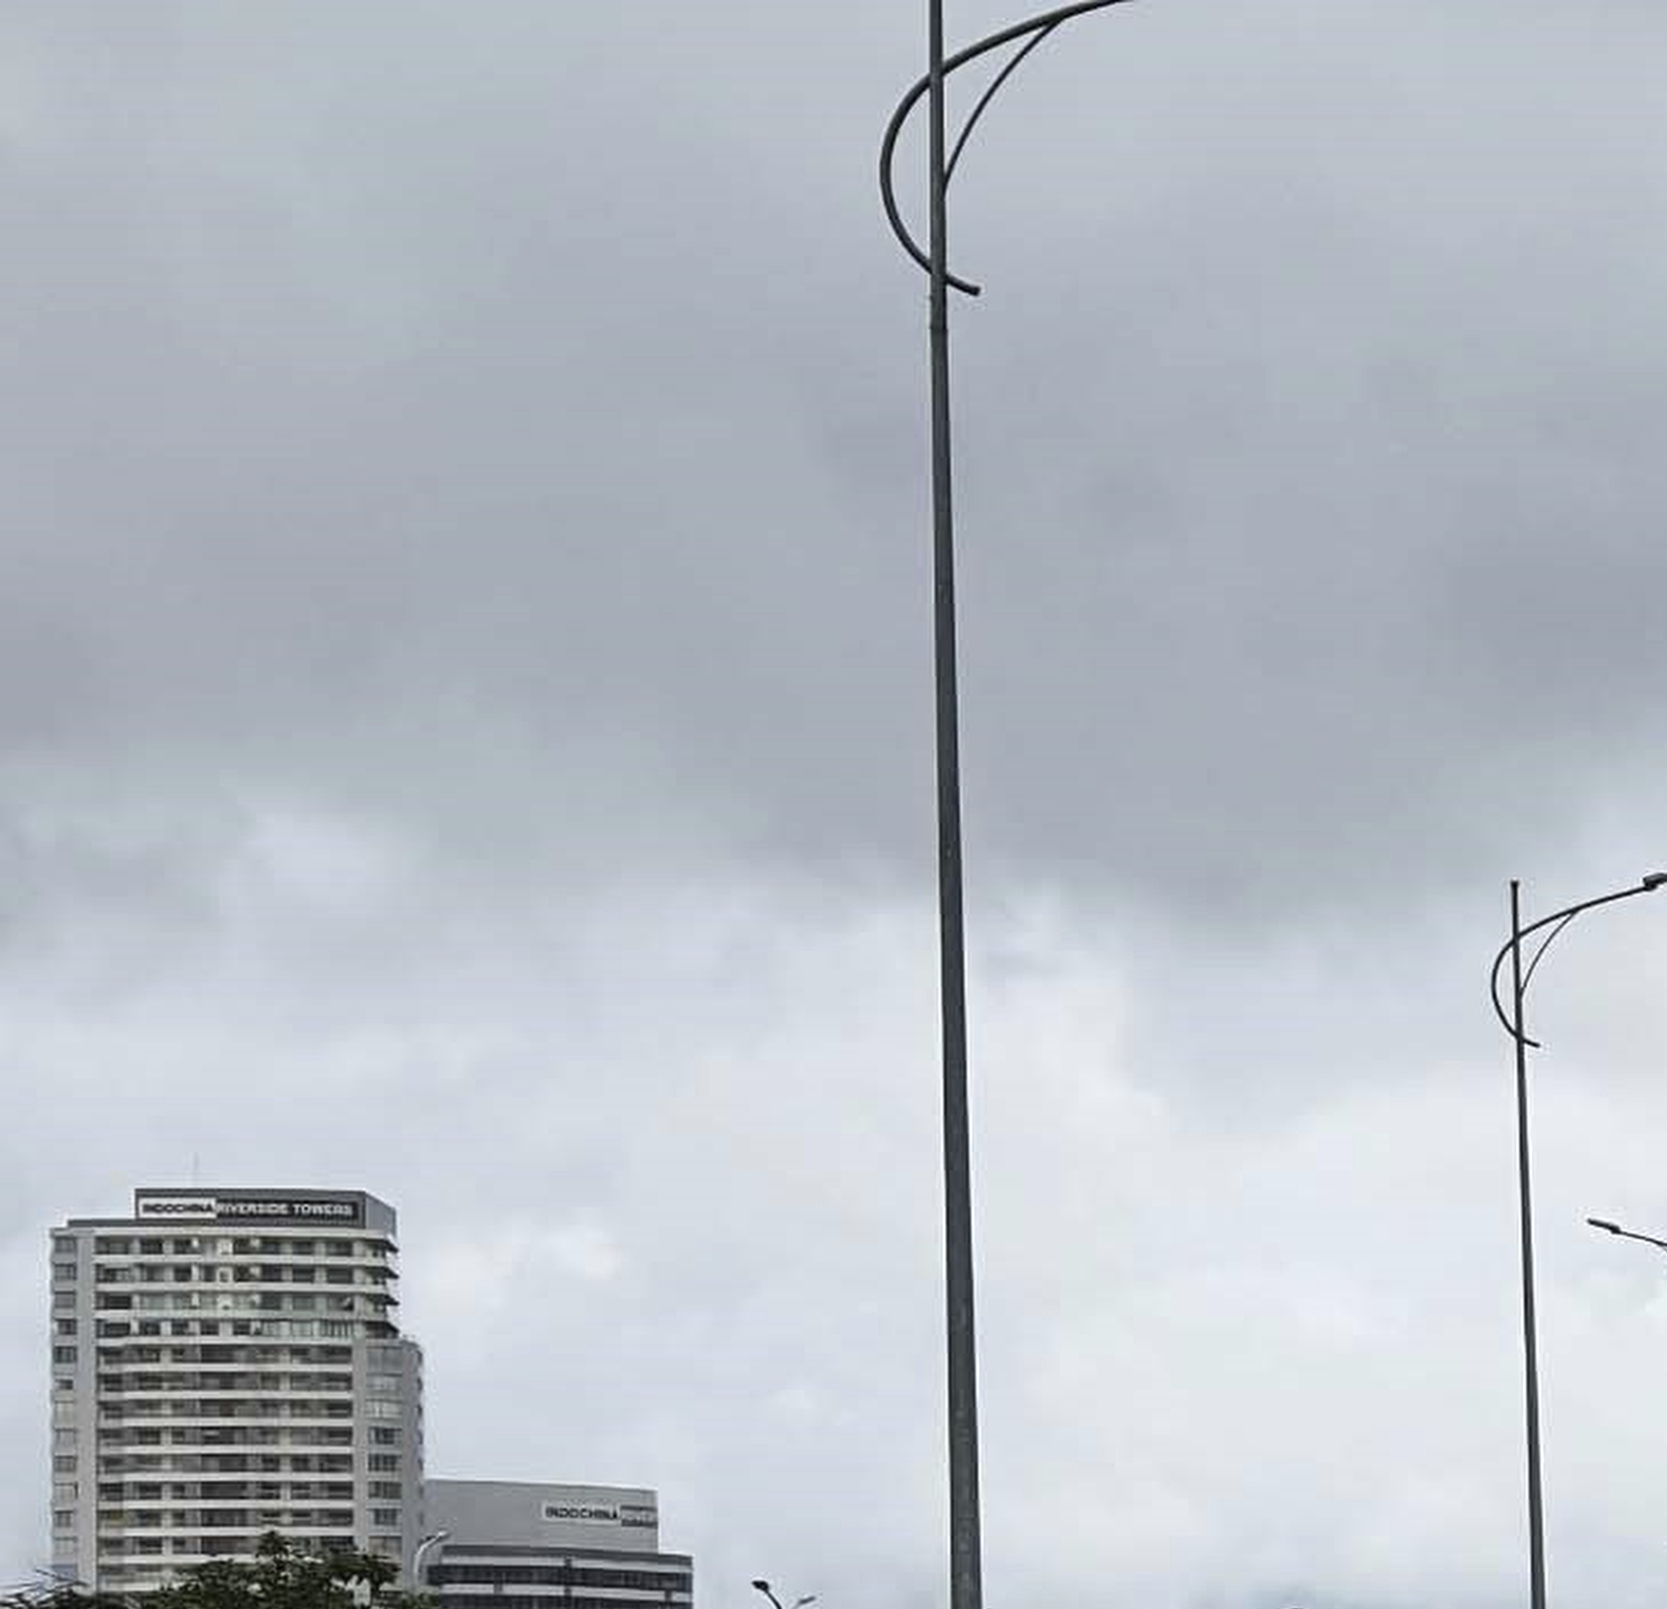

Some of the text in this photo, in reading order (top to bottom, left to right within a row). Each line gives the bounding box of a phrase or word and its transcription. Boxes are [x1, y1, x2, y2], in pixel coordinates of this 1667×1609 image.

[142, 1201, 354, 1216] INDOCHINA RIVERSIDE TOWERS
[544, 1506, 618, 1520] INDOCHINA
